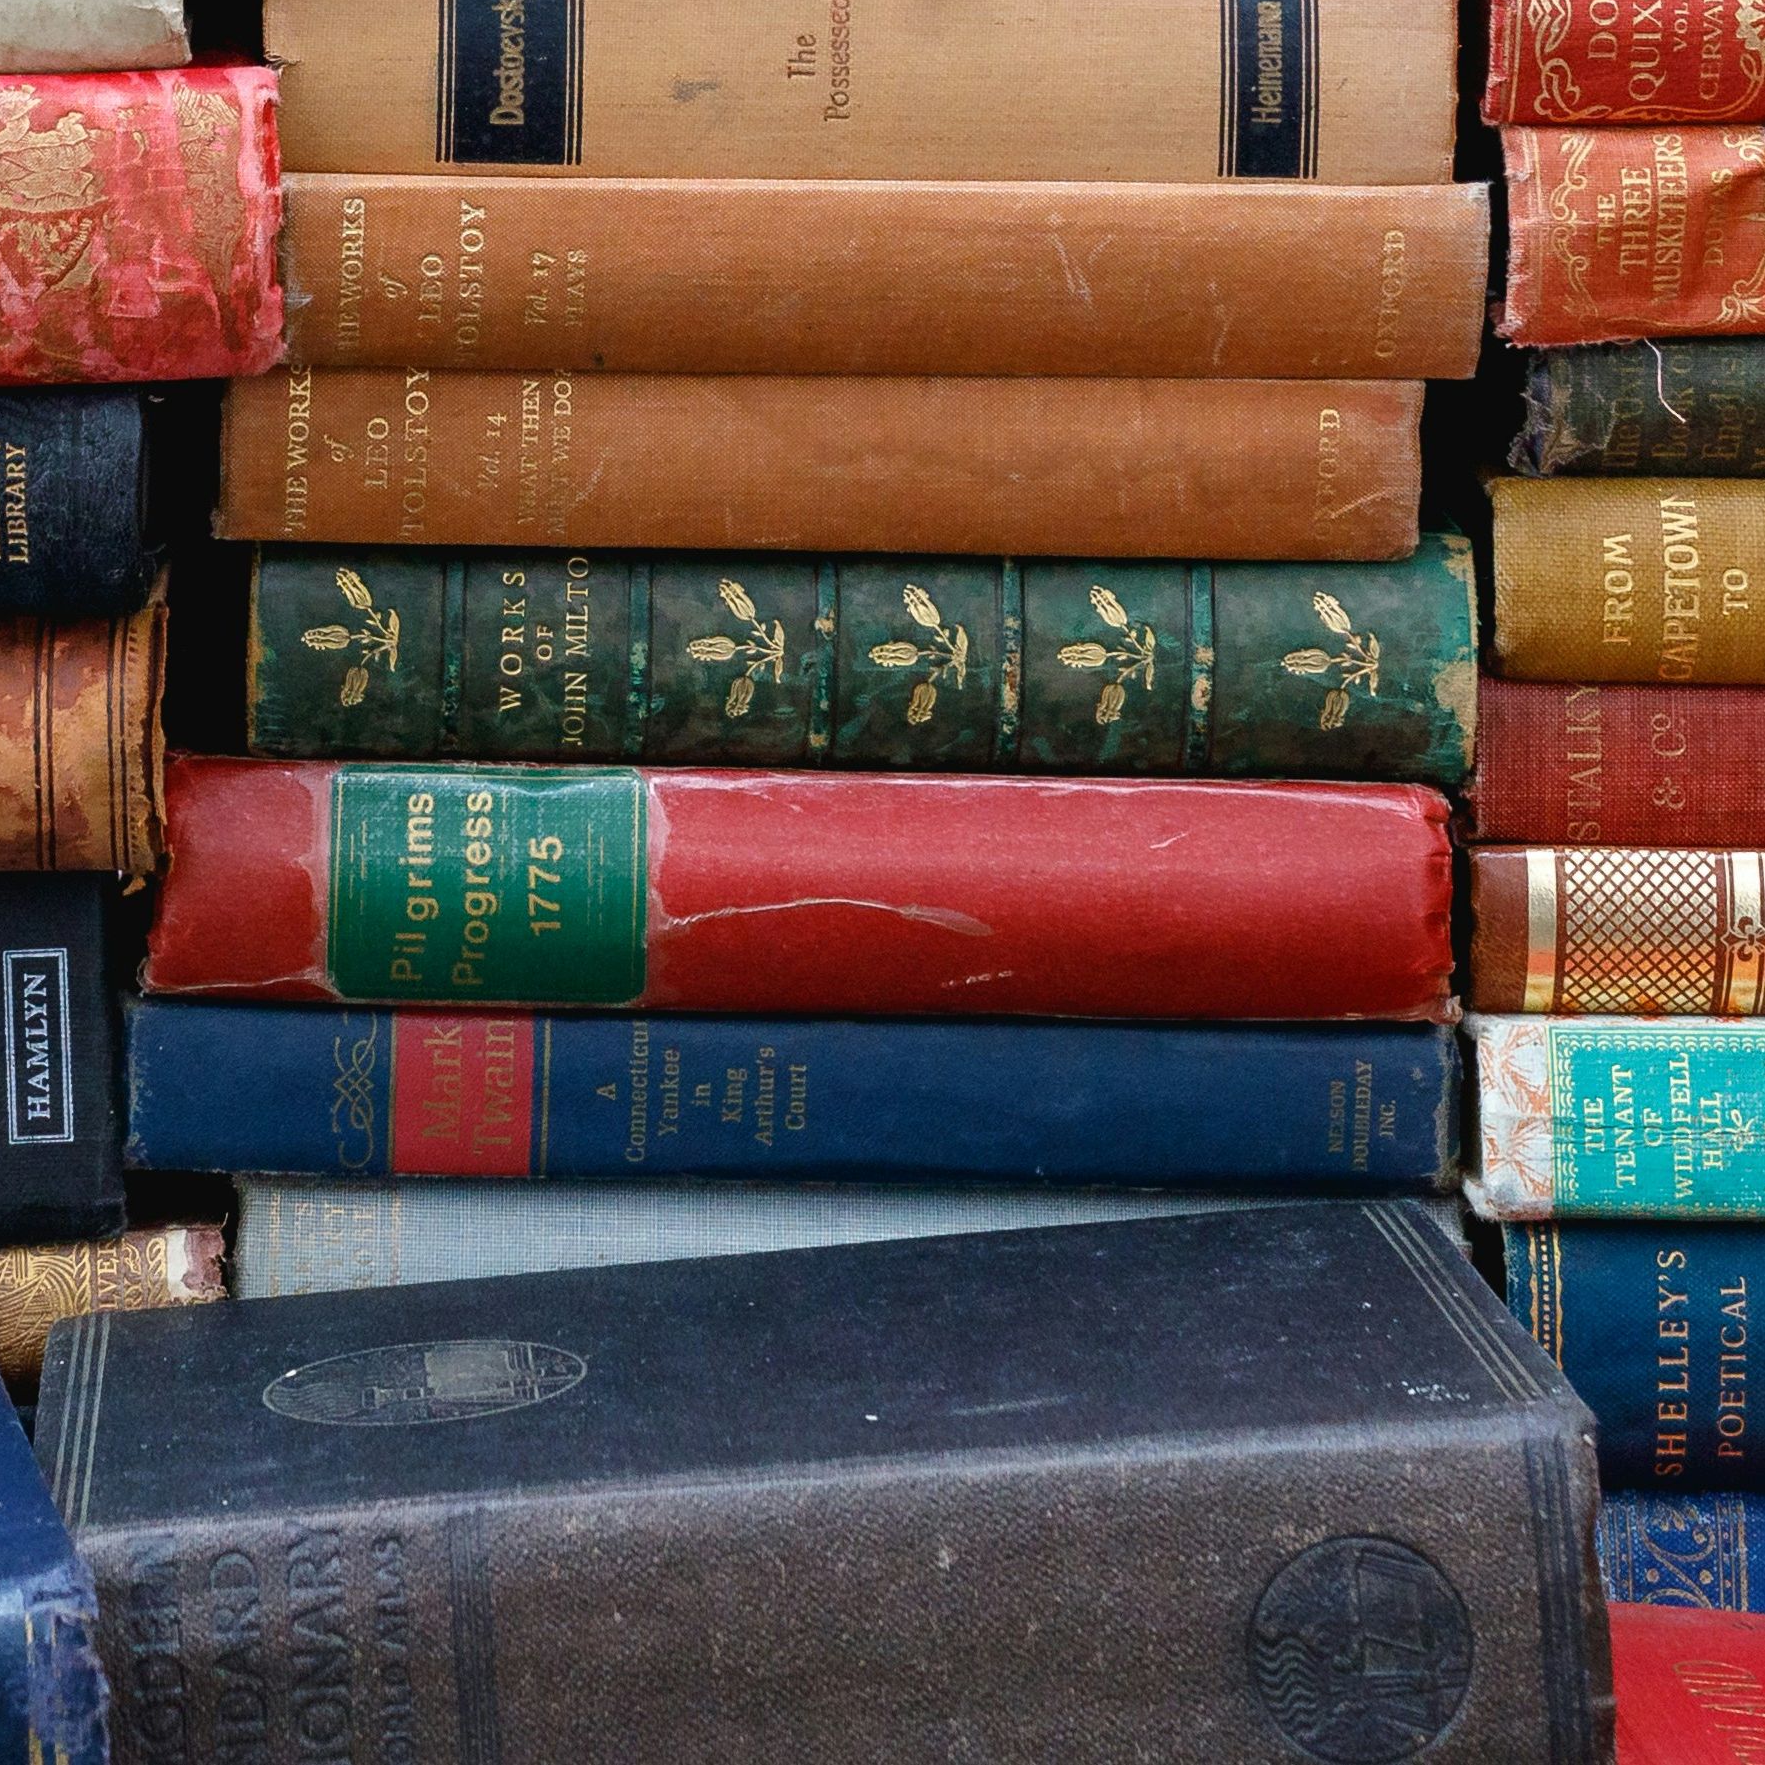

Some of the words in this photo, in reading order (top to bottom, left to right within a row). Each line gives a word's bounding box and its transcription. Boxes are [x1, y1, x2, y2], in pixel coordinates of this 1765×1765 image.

[1252, 0, 1283, 124] Heinemann
[1619, 167, 1650, 275] THREE
[1651, 133, 1688, 305] MUSKETEERS
[6, 442, 30, 564] LIBRARY
[499, 570, 524, 712] WORKS
[564, 556, 589, 659] MILTO
[1603, 534, 1633, 646] FROM
[1722, 568, 1749, 615] TO
[562, 671, 587, 746] JOHN
[1564, 687, 1601, 842] STALKY
[391, 792, 439, 984] Pilgrims
[452, 791, 496, 987] Progress
[533, 835, 564, 938] 1775
[25, 973, 51, 1121] HAMLYN
[421, 1022, 463, 1144] Mark
[472, 1016, 516, 1158] Twain
[657, 1047, 682, 1136] Yankee
[753, 1046, 775, 1146] Arthur's
[785, 1064, 807, 1130] Court
[1612, 1065, 1635, 1187] TENANT
[1670, 1052, 1694, 1198] WILDFELL
[1701, 1092, 1723, 1170] HALL
[1718, 1276, 1747, 1457] POETICAL
